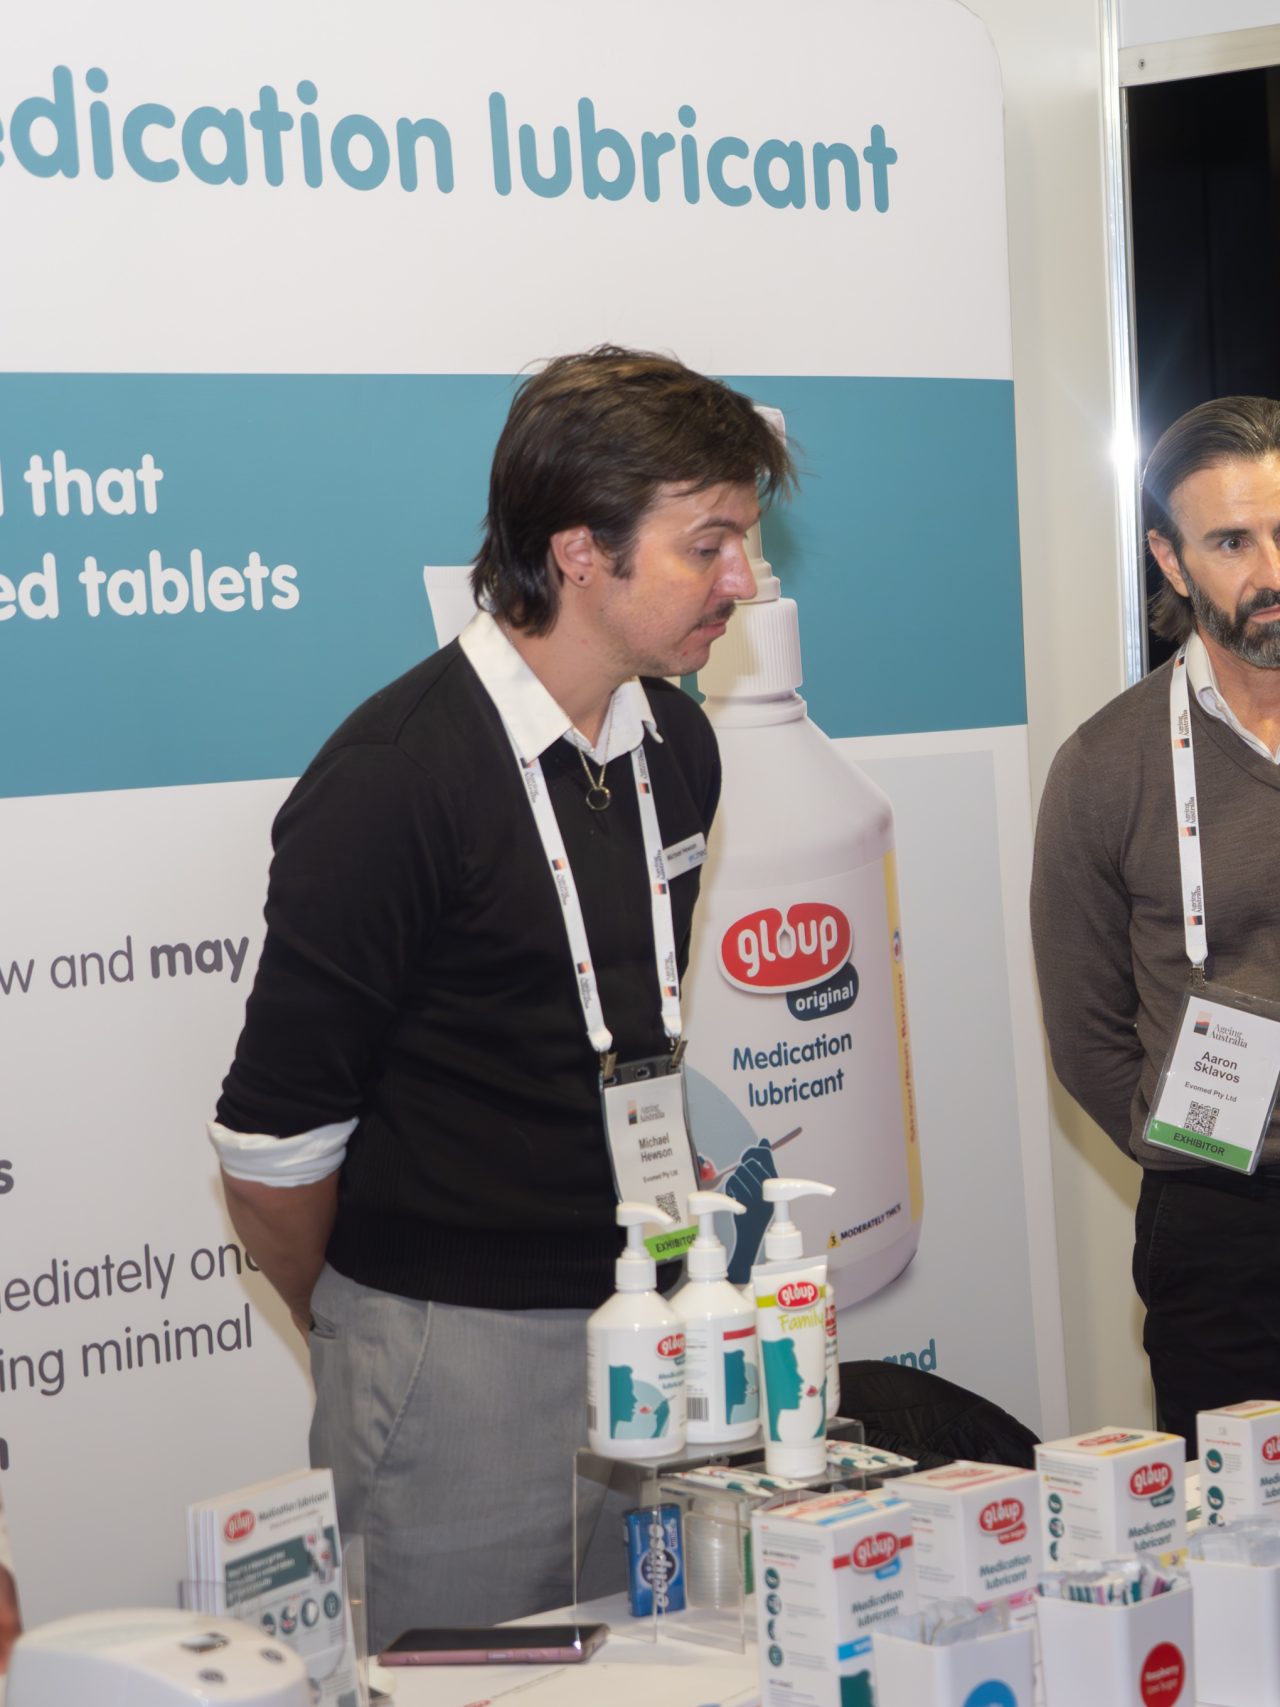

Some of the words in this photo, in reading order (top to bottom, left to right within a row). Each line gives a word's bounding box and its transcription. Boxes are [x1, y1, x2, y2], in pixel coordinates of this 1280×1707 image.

[0, 65, 453, 193] dication
[488, 91, 898, 213] lubricant
[23, 449, 164, 517] that
[78, 548, 300, 617] tablets
[737, 915, 839, 978] gloup
[50, 935, 134, 989] and
[150, 936, 249, 983] may
[795, 981, 854, 1012] original
[1209, 1030, 1248, 1049] Australia
[1214, 1024, 1243, 1038] Ageing
[732, 1032, 852, 1071] Medication
[1201, 1051, 1238, 1071] Aaron
[1193, 1060, 1240, 1084] Sklavos
[748, 1068, 844, 1107] lubricant
[1184, 1081, 1212, 1095] Evomed
[1213, 1088, 1225, 1100] Pty
[1226, 1092, 1238, 1103] Ltd
[638, 1132, 670, 1151] Michael
[641, 1146, 673, 1163] Hewson
[1173, 1132, 1225, 1155] EXHIBITOR
[840, 1213, 885, 1240] MODERATELY
[0, 1243, 175, 1313] ediately
[782, 1284, 814, 1306] gloup
[82, 1302, 252, 1377] minimal
[1134, 1467, 1168, 1493] gloup
[984, 1502, 1019, 1529] gloup
[1128, 1518, 1176, 1539] Medication
[979, 1554, 1032, 1577] Medication
